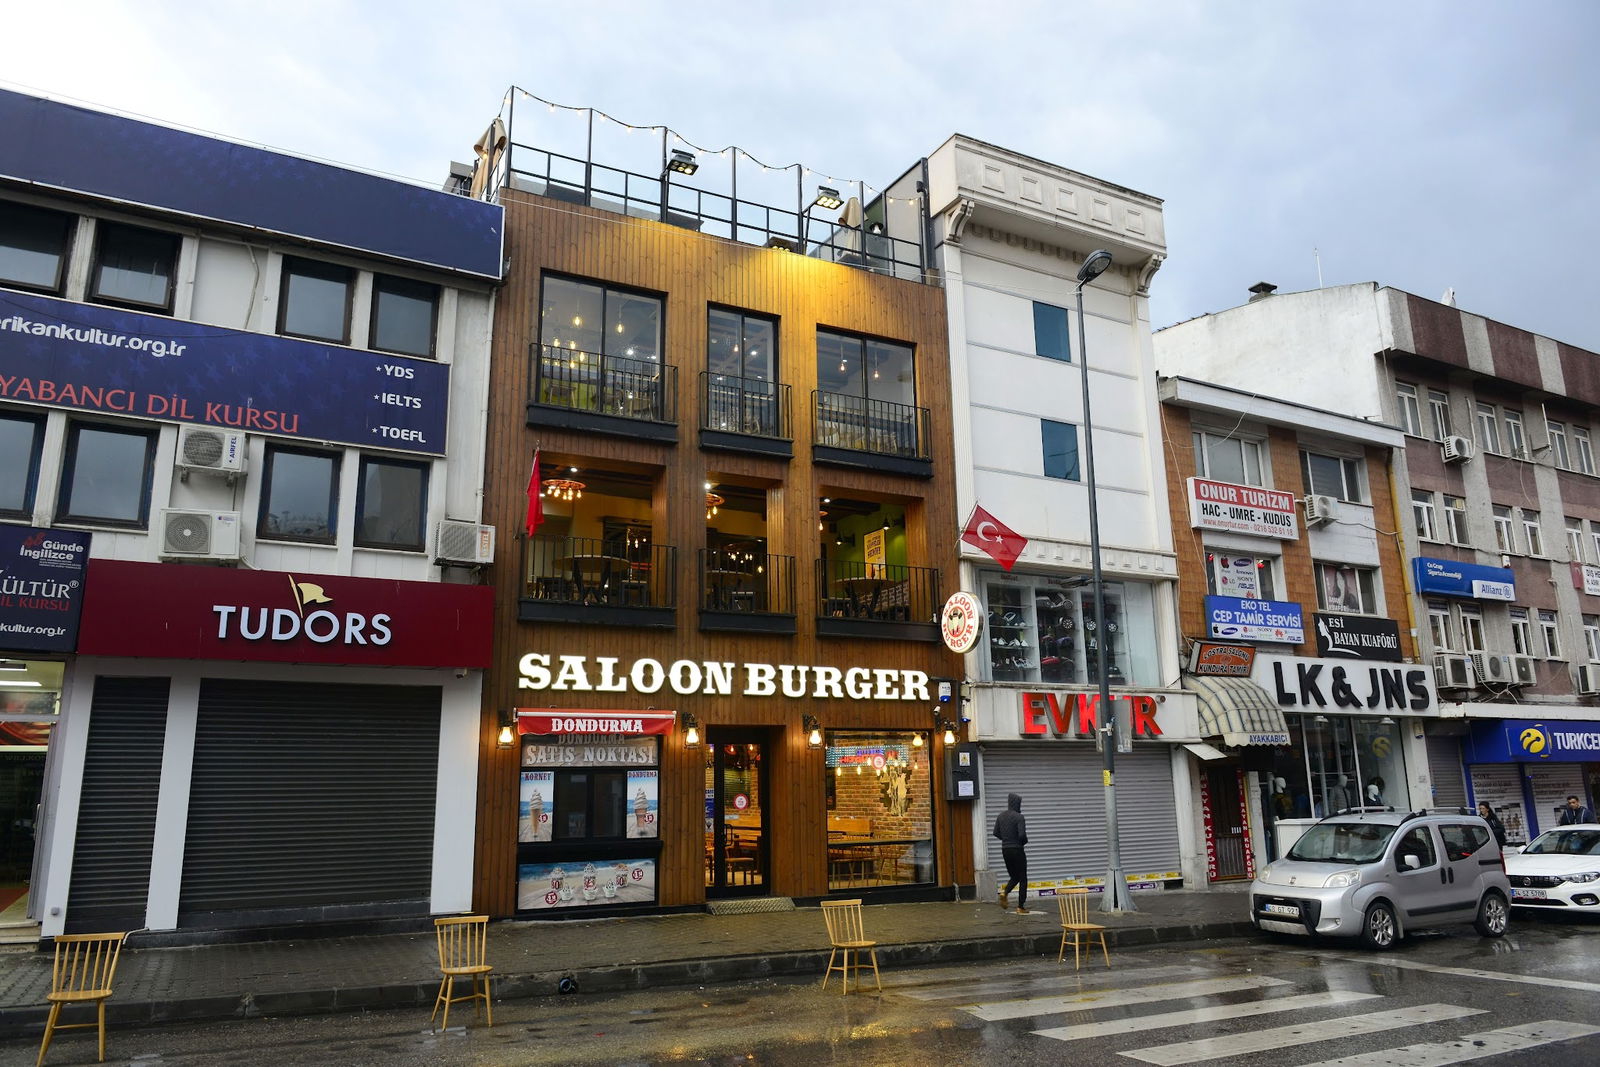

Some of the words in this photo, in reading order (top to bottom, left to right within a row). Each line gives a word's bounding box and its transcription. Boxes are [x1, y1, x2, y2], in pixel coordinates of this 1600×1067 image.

[0, 315, 187, 358] rikankultur.org.tr
[384, 364, 414, 379] YDS
[0, 374, 135, 412] YABANCI
[147, 393, 195, 420] DİL
[205, 402, 299, 433] KURSU
[382, 392, 421, 409] IELTS
[380, 425, 426, 443] TOEFL
[229, 436, 237, 459] AIRFEL
[1200, 482, 1238, 503] ONUR
[1240, 488, 1290, 511] TURİZM
[1201, 502, 1221, 516] HAC
[1229, 506, 1256, 522] UMRE
[1263, 511, 1292, 527] KUDÜS
[20, 545, 74, 560] İngilizce
[42, 540, 84, 553] Günde
[0, 570, 71, 599] ÜLTÜR
[1481, 583, 1503, 596] Allianz
[18, 597, 71, 612] KURSU
[1240, 600, 1257, 611] EKO
[1258, 602, 1271, 612] TEL
[213, 605, 392, 646] TUDORS
[1213, 609, 1232, 622] CEP
[1234, 610, 1265, 626] TAMİR
[1266, 613, 1302, 628] SERVİSİ
[1328, 616, 1344, 628] ESİ
[1333, 631, 1360, 646] BAYAN
[1361, 633, 1398, 649] KUAFÖRÜ
[518, 653, 736, 695] SALOON
[743, 663, 931, 700] BURGER
[1198, 663, 1228, 673] KUNDURA
[1022, 691, 1164, 737] EVKR
[551, 718, 643, 732] DONDURMA
[1554, 732, 1600, 750] TURKCE
[583, 745, 654, 763] NOKTASI
